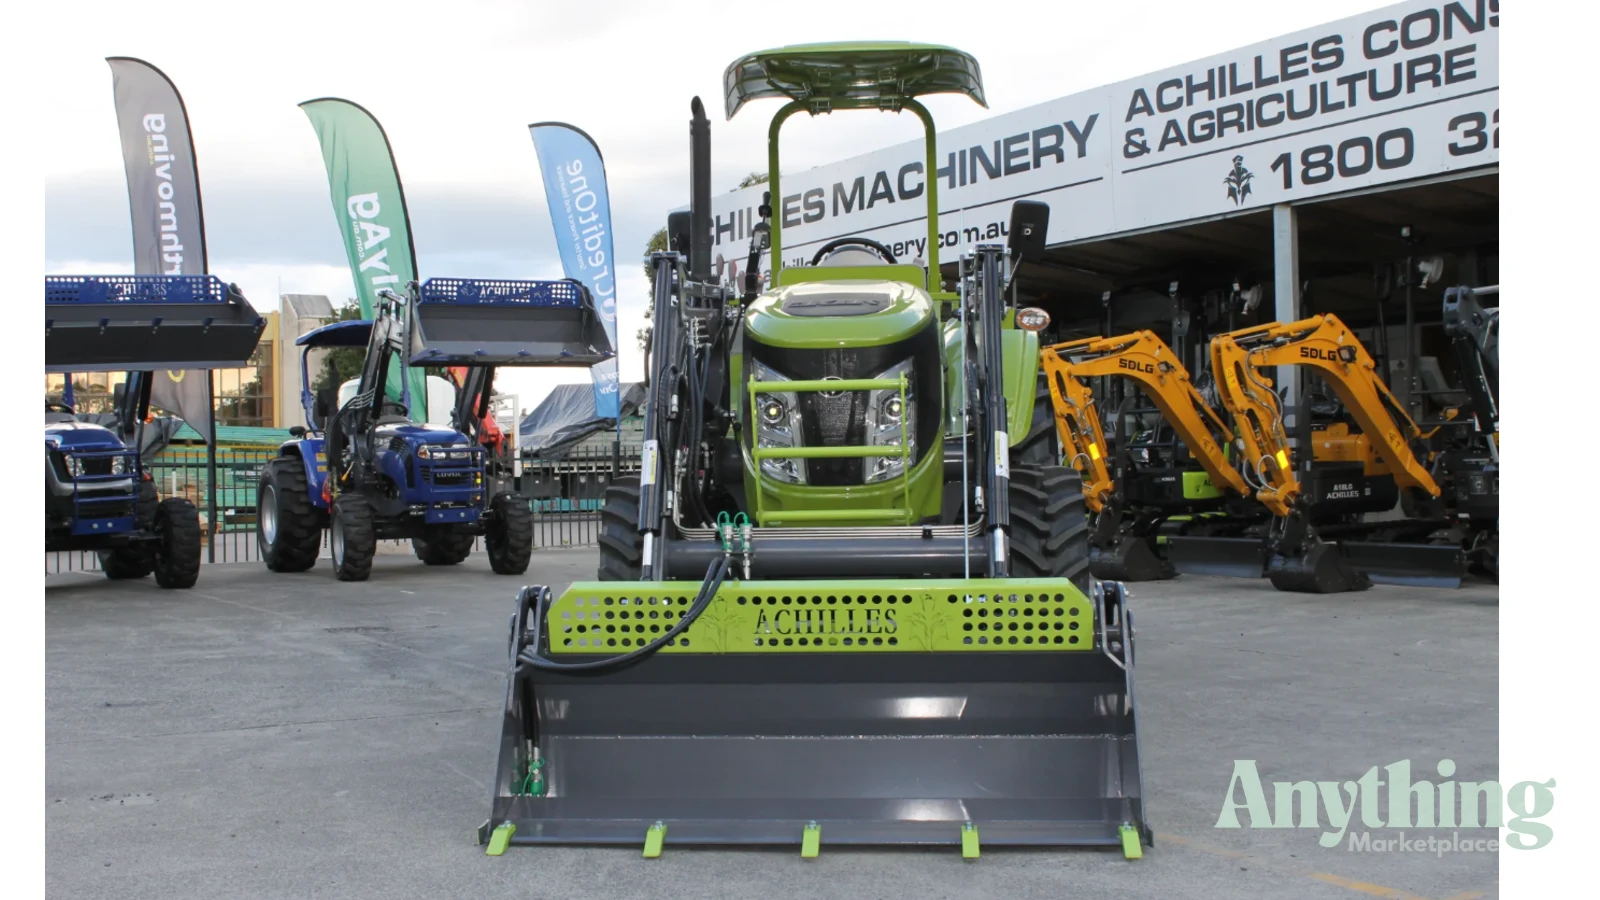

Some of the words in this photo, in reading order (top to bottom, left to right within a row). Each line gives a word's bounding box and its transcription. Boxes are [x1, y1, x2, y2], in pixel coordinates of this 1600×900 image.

[1124, 33, 1345, 123] ACHILLES
[1123, 127, 1151, 159] &
[1157, 43, 1477, 152] AGRICULTURE
[1270, 126, 1414, 190] 1800
[1447, 108, 1498, 157] 3
[1118, 358, 1154, 374] SDLG
[1300, 346, 1338, 361] SDLG
[1326, 490, 1359, 500] ACHILLES
[753, 608, 898, 635] ACHILLES
